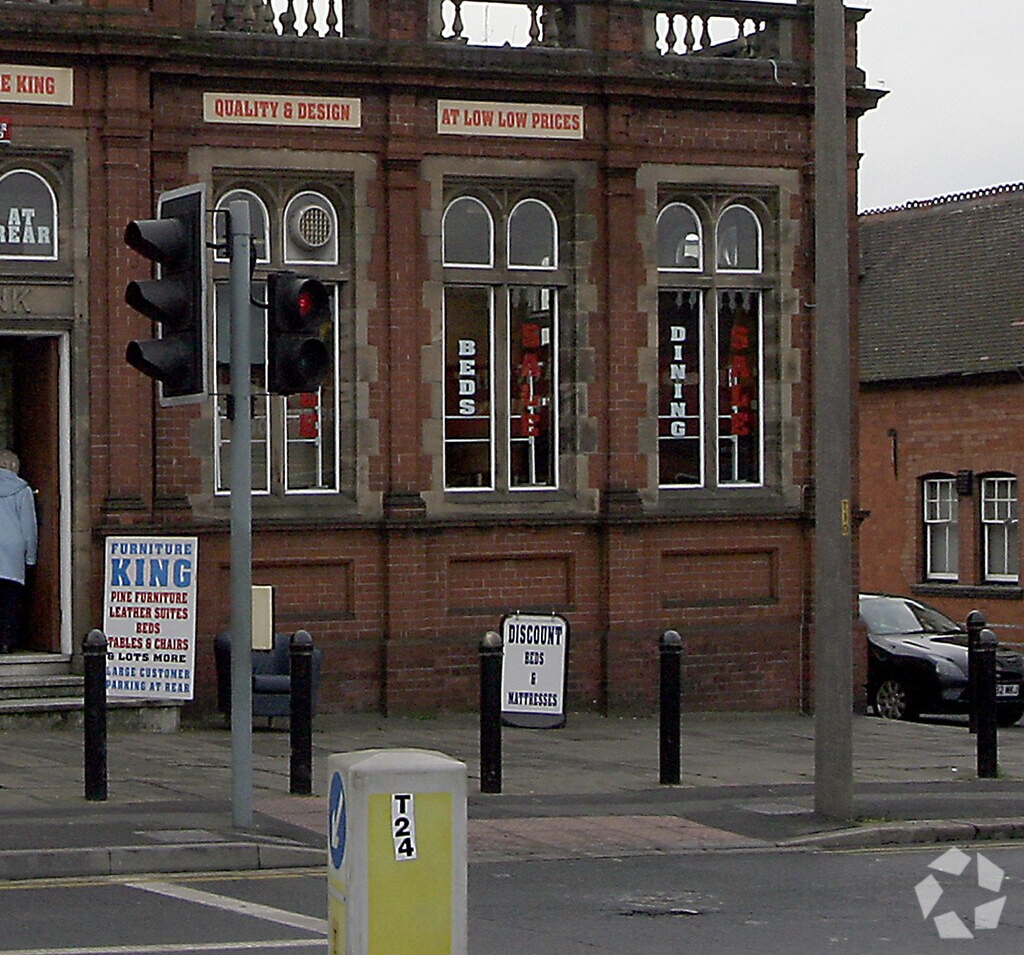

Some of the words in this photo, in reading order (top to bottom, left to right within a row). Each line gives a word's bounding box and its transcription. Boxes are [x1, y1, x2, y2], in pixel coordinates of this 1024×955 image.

[17, 75, 56, 94] KING
[215, 99, 279, 119] QUALITY
[283, 102, 293, 120] &
[298, 103, 350, 122] DESIGN
[441, 109, 460, 126] AT
[464, 110, 493, 127] LOW
[498, 112, 527, 129] LOW
[531, 113, 580, 131] PRICES
[8, 208, 35, 225] AT
[458, 340, 476, 415] BEDS
[670, 326, 686, 436] DINING
[111, 543, 192, 555] FURNITURE
[111, 558, 191, 588] KING
[111, 591, 132, 603] PINE
[135, 592, 188, 604] FURNITURE
[109, 606, 152, 619] LEATHER
[154, 607, 188, 620] SUITES
[136, 622, 160, 634] BEDS
[509, 624, 562, 645] DISCOUNT
[108, 638, 144, 649] TABLES
[154, 639, 189, 650] CHAIRS
[118, 653, 149, 662] LOTS
[153, 653, 186, 663] MORE
[524, 651, 544, 665] BEDS
[106, 666, 136, 677] LARGE
[140, 667, 190, 679] CUSTOMER
[106, 680, 146, 691] PARKING
[150, 682, 161, 692] AT
[165, 682, 190, 693] REAR
[508, 692, 558, 707] MATTRESSES
